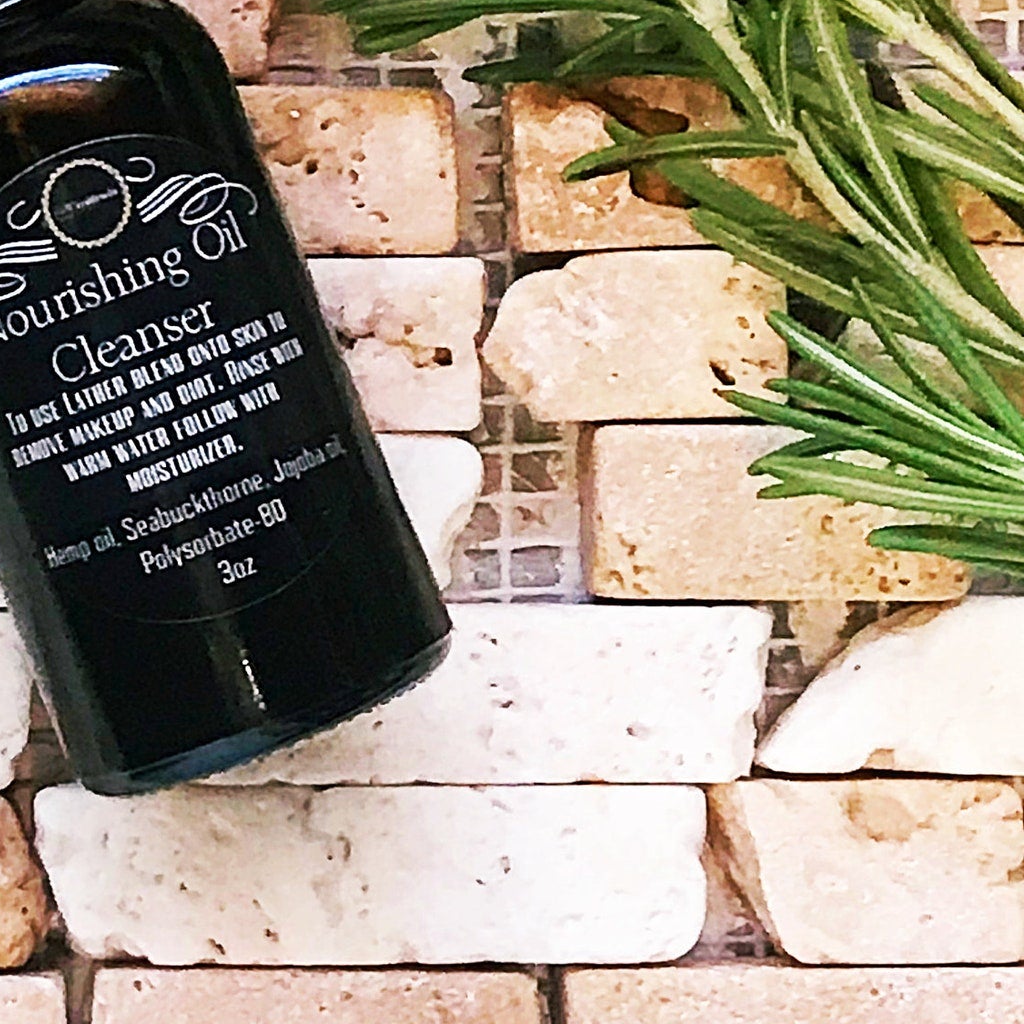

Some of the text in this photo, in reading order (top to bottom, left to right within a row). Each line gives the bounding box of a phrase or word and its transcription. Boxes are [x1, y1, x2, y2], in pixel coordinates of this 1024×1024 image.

[192, 209, 248, 261] Oil
[52, 300, 216, 383] Cleanser
[129, 352, 185, 390] BLEND
[187, 333, 231, 366] ONTO
[231, 319, 268, 348] SKIN
[61, 381, 281, 483] WARM WATER FOLLOW WITH
[68, 405, 135, 447] MAKEUP
[140, 391, 175, 420] AND
[43, 540, 92, 569] Hemp
[273, 446, 326, 483] Jojoba
[217, 556, 258, 585] 3oz
